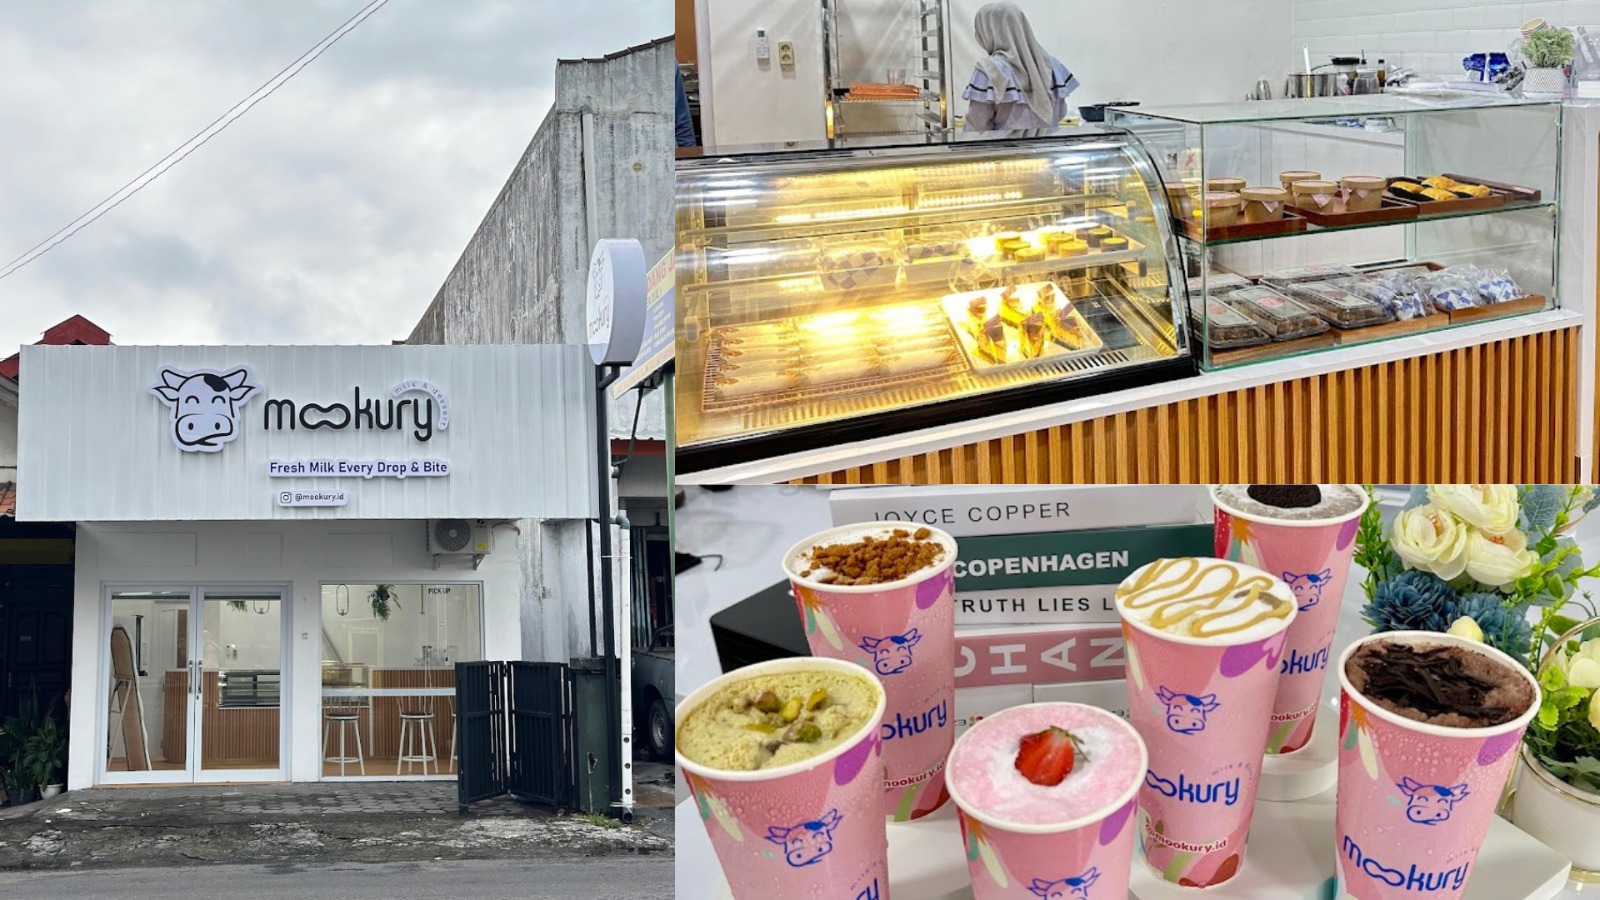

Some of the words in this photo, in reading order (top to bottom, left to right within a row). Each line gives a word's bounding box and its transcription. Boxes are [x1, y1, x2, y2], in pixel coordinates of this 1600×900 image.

[264, 386, 432, 441] mookury
[395, 382, 416, 394] milk
[432, 389, 448, 426] dessert
[270, 462, 305, 473] Fresh
[309, 462, 334, 473] Milk
[339, 462, 373, 475] Every
[377, 462, 406, 475] Drop
[411, 462, 419, 473] &
[423, 462, 447, 473] Bite
[295, 493, 344, 502] @mookury.id
[968, 502, 1070, 522] COPPER
[953, 550, 1129, 577] COPENHAGEN
[954, 598, 1025, 613] RUTH
[1038, 597, 1090, 612] LIES
[1343, 835, 1469, 891] mookury
